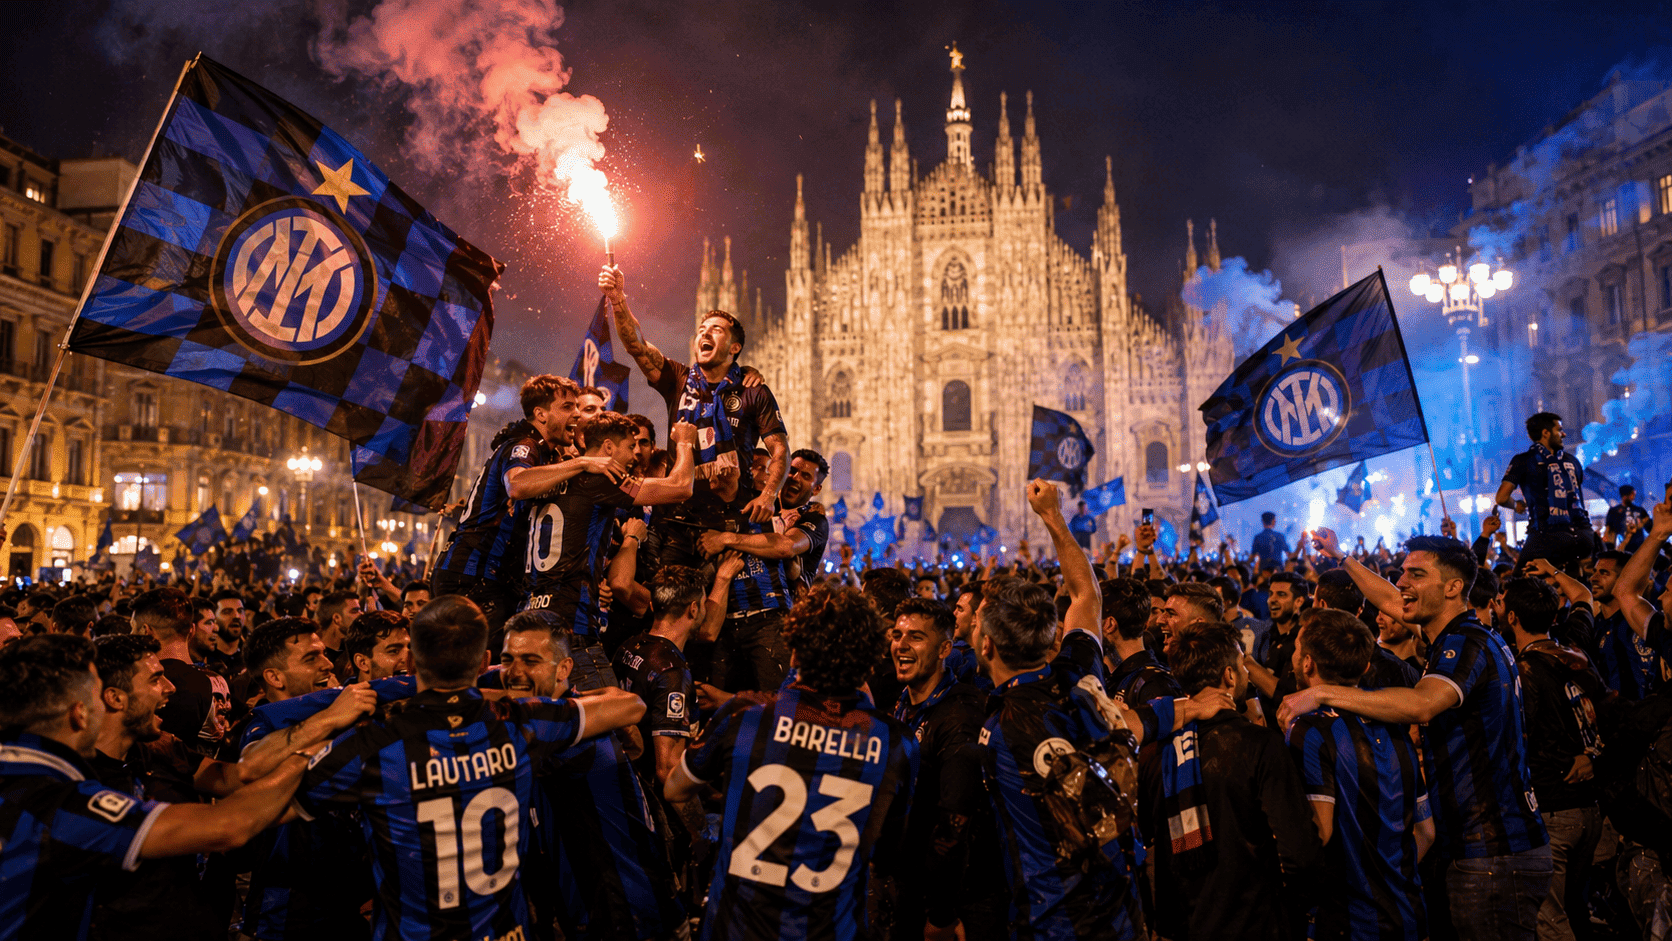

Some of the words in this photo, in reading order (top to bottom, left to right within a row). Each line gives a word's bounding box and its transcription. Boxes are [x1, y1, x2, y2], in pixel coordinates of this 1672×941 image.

[525, 502, 565, 574] 10
[410, 742, 517, 790] LAUTARO
[773, 715, 882, 764] BARELLA
[416, 786, 520, 910] 10
[728, 763, 874, 893] 23
